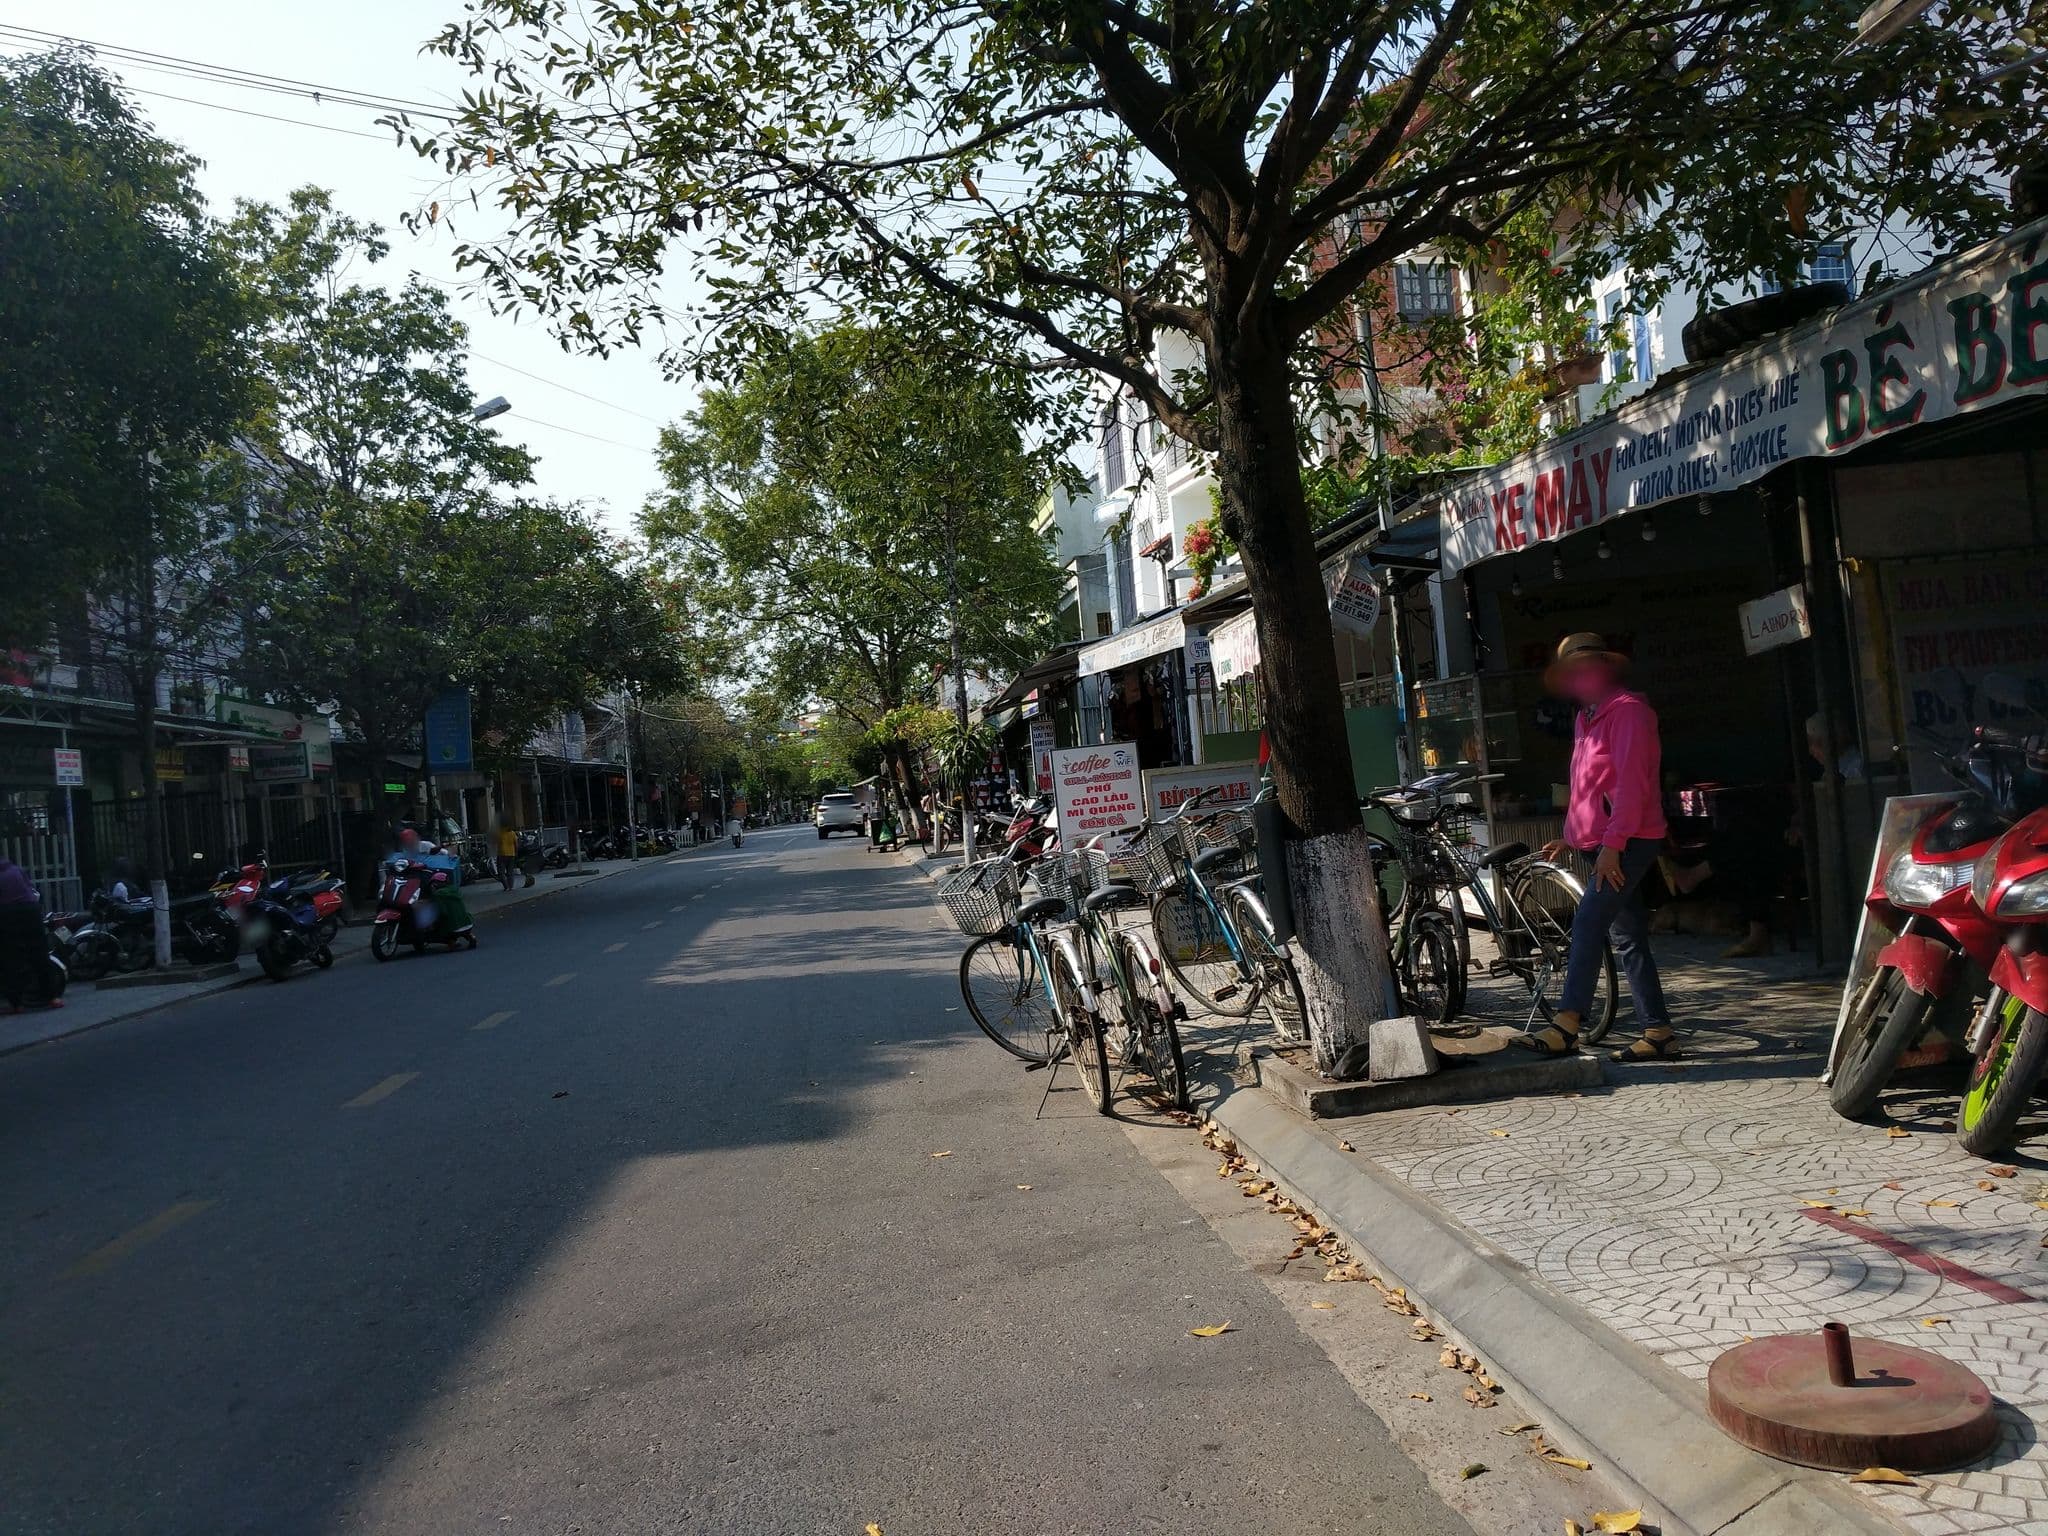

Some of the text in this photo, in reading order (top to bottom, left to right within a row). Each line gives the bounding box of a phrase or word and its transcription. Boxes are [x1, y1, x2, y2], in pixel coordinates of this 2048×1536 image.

[1820, 230, 2048, 450] BÉ BÉ
[1616, 438, 1636, 473] FOR
[1675, 404, 1722, 450] MOTOR
[1725, 384, 1766, 431] BIKES
[1490, 443, 1612, 551] XE MÁY
[1632, 465, 1674, 506] MOTOR
[1678, 450, 1718, 495] BIKES
[1071, 754, 1111, 774] coffee
[1071, 796, 1099, 807] CAO
